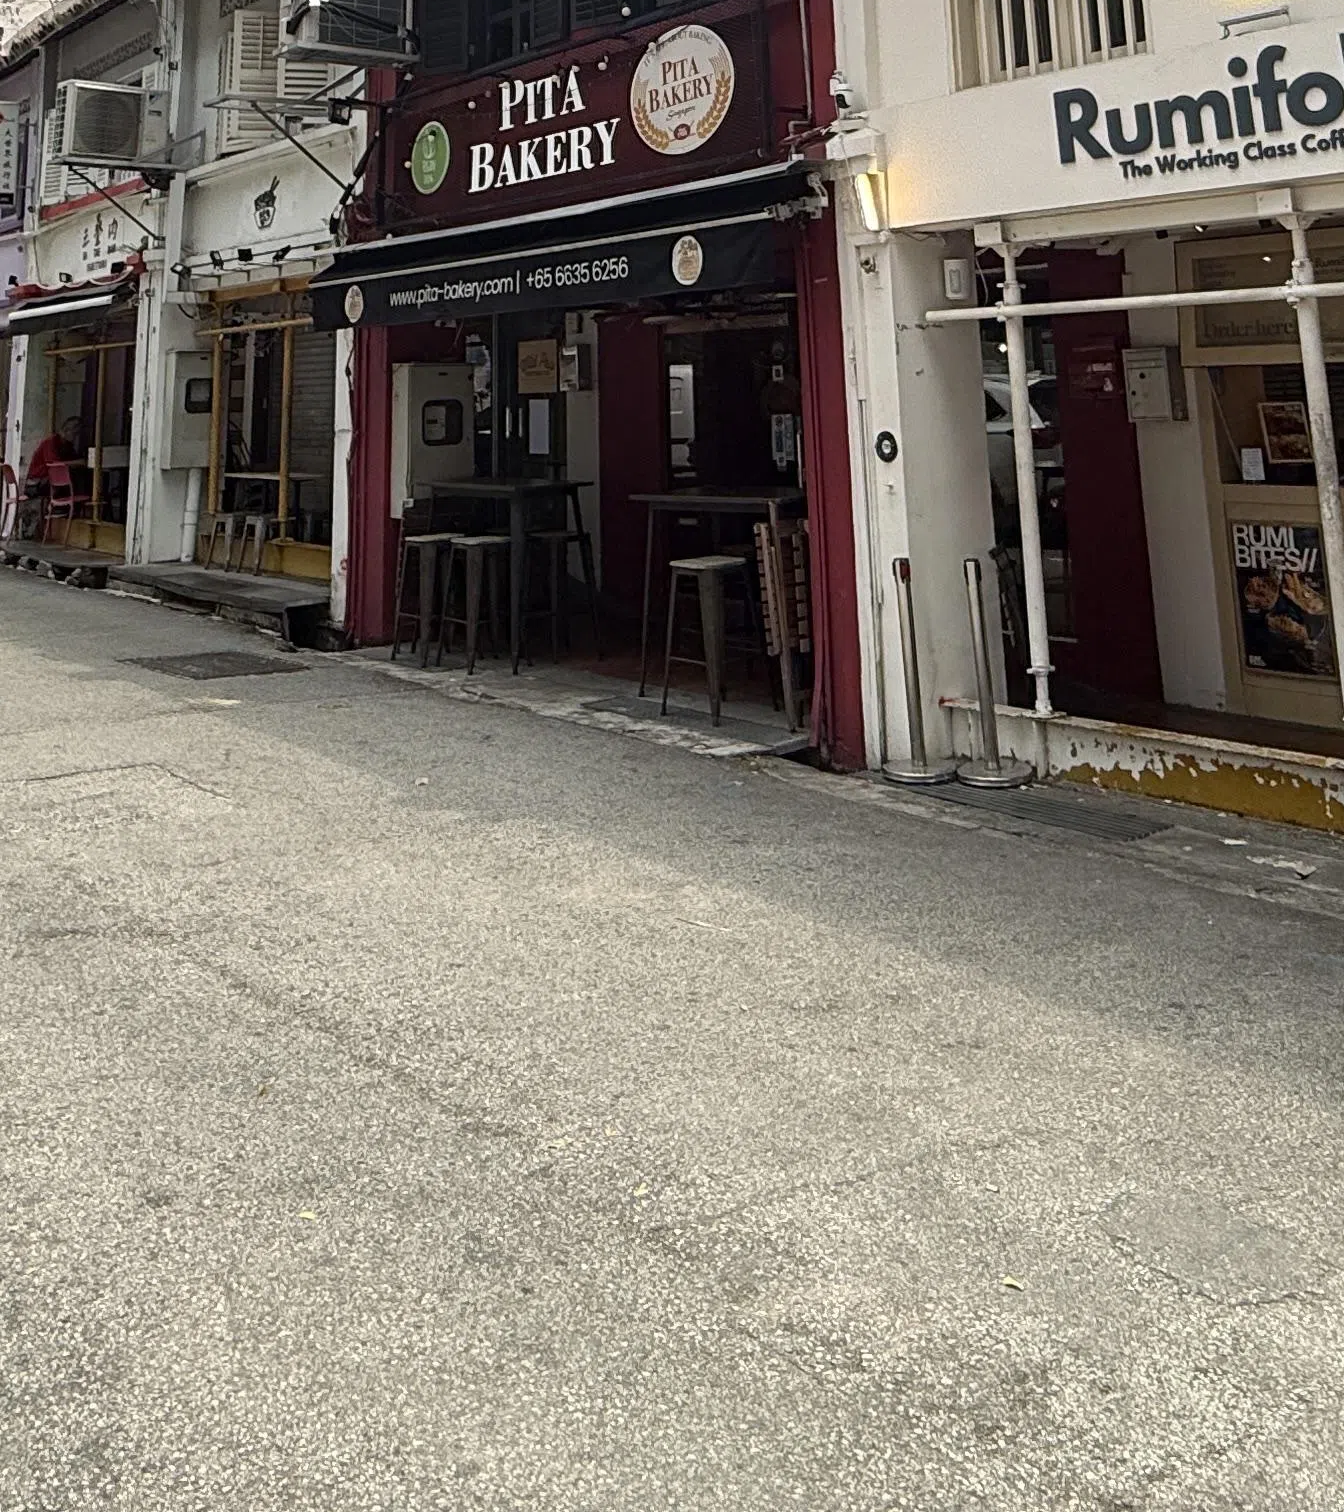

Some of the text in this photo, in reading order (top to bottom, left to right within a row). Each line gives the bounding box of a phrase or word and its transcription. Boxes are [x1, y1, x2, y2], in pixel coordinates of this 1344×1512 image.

[661, 56, 700, 85] PITA
[498, 65, 587, 131] PITA
[648, 73, 714, 114] BAKERY
[468, 117, 621, 193] BAKERY
[1119, 159, 1153, 180] The
[1155, 148, 1240, 176] Working
[1242, 141, 1298, 162] Class
[389, 275, 514, 309] www.pita-bakery.com
[526, 266, 553, 289] +65
[555, 261, 590, 287] 6635
[592, 256, 629, 282] 6256
[1233, 524, 1295, 548] RUMI
[1235, 545, 1318, 573] BITES//
